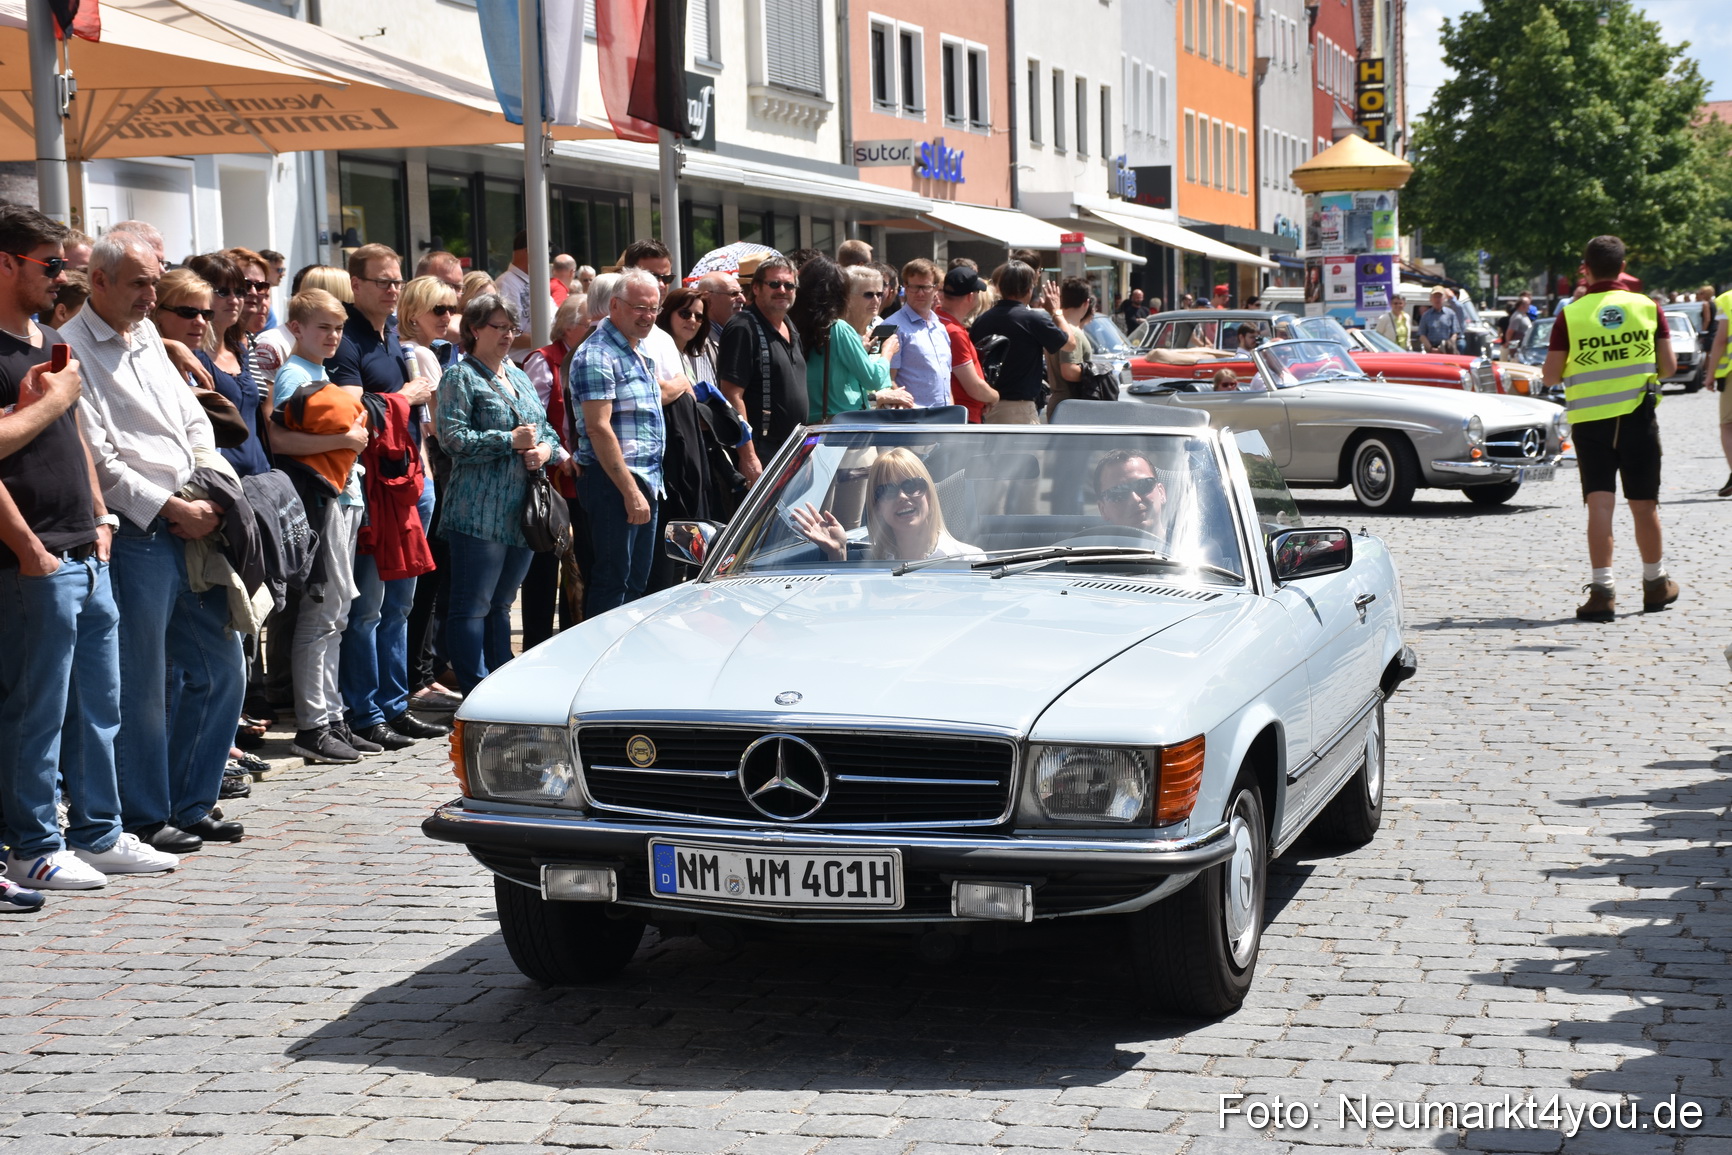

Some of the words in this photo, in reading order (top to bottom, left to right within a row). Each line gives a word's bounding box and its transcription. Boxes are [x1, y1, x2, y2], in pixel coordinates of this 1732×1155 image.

[1578, 329, 1649, 351] FOLLOW
[1602, 347, 1629, 363] ME
[662, 873, 670, 884] D
[677, 852, 720, 891] NM
[746, 858, 791, 896] WM
[802, 860, 892, 898] 401H
